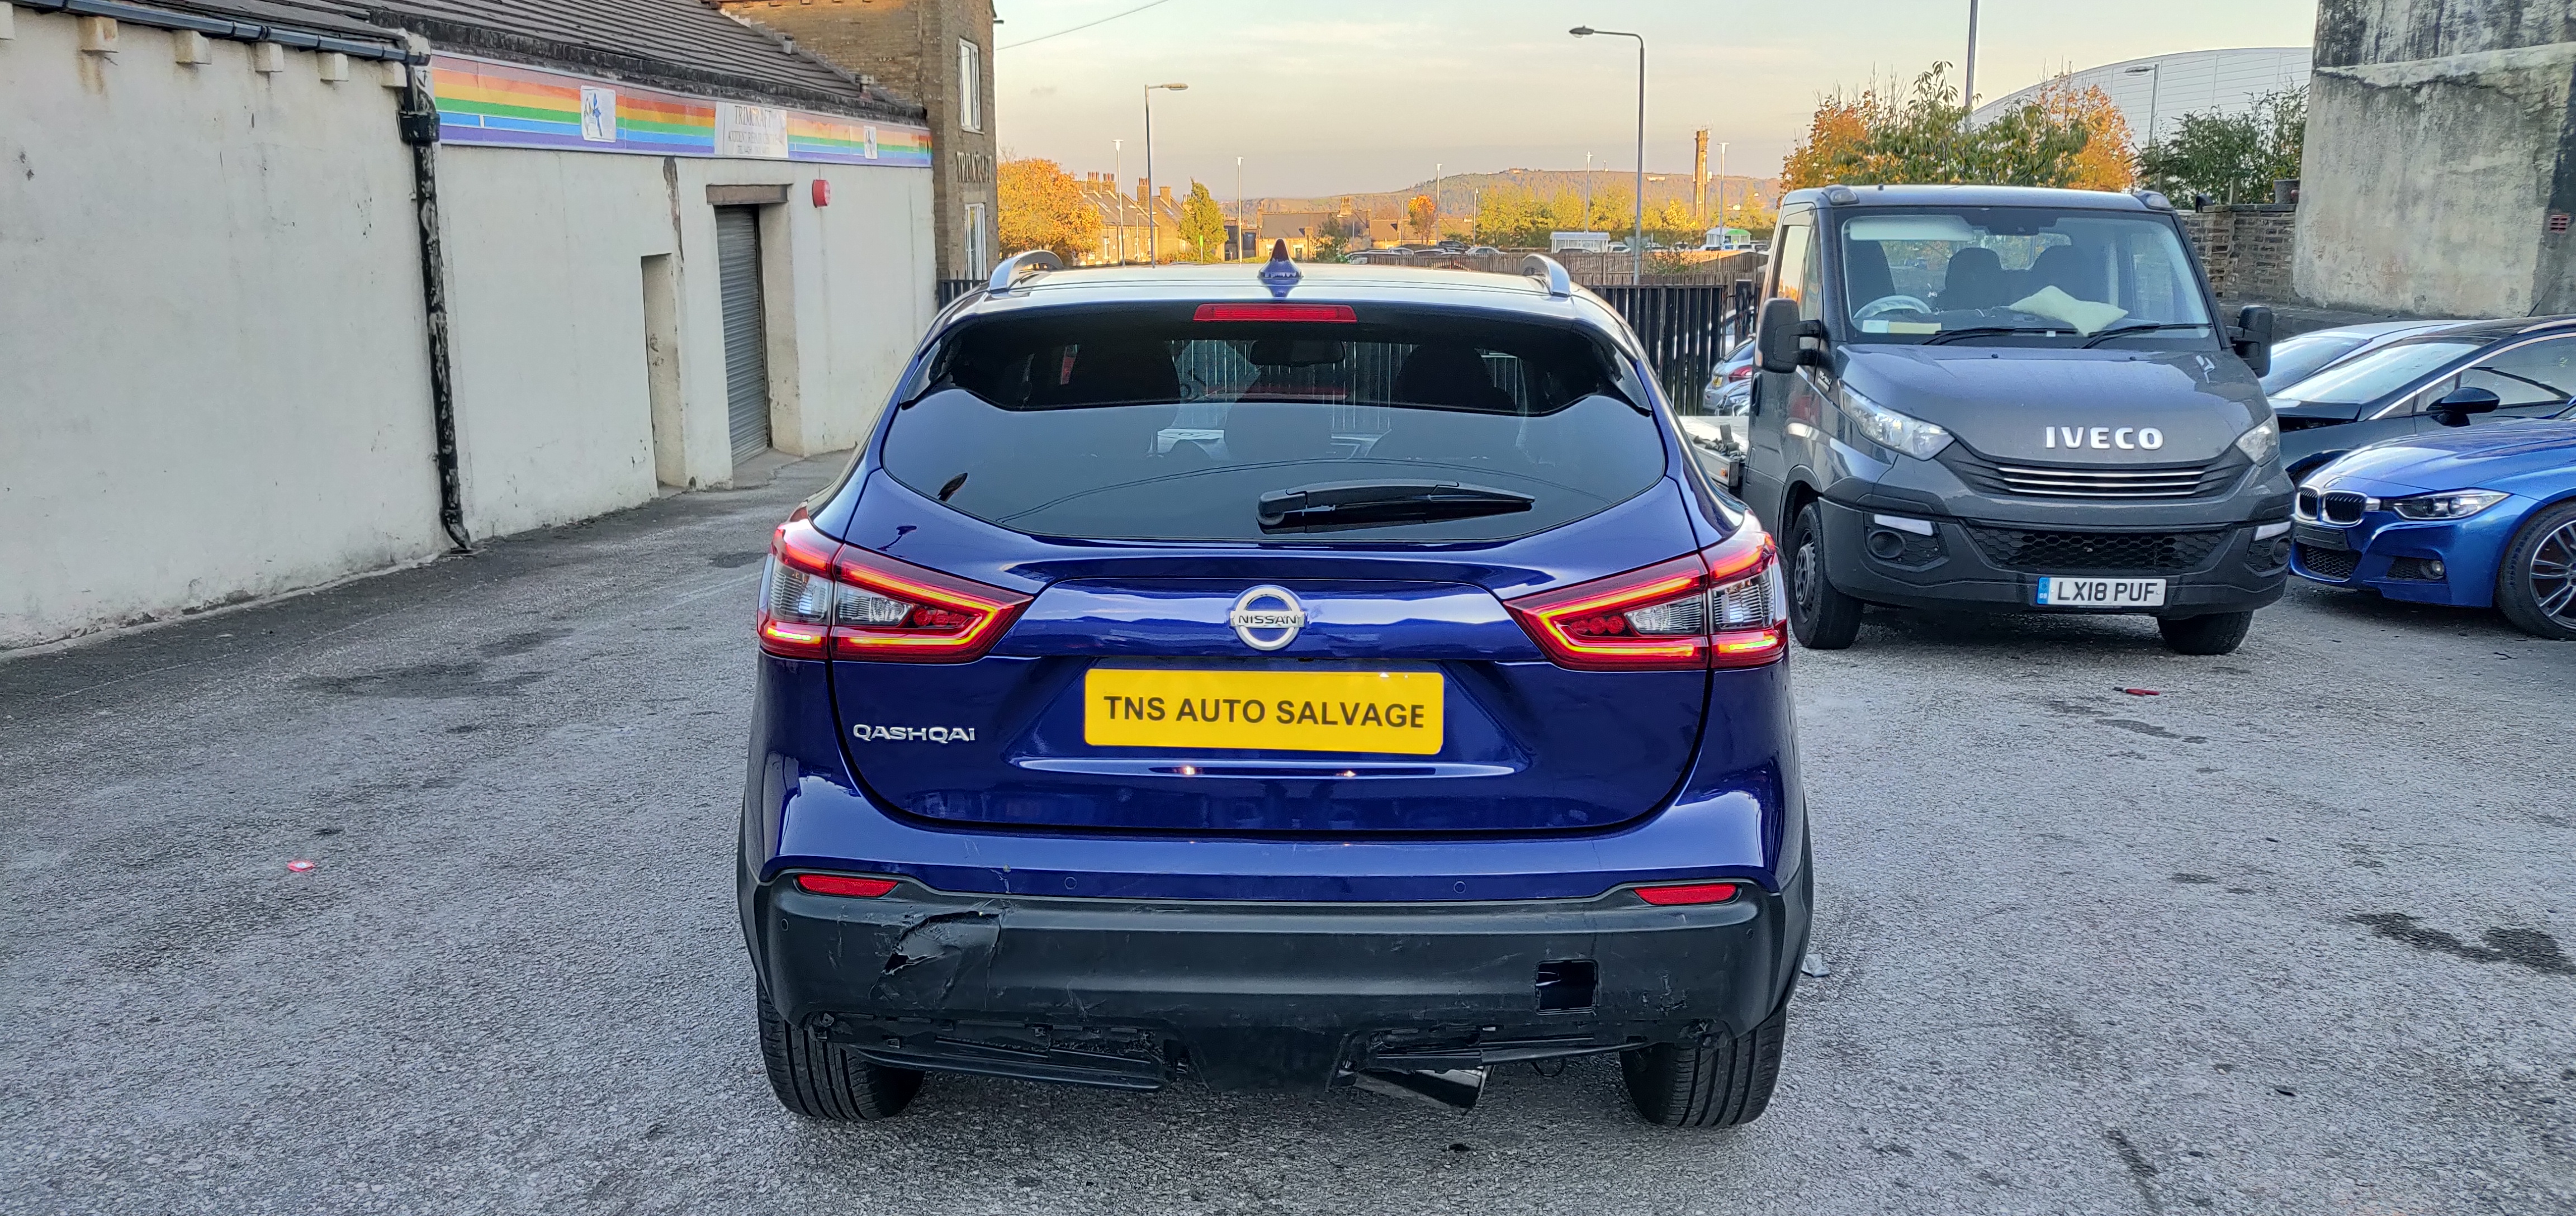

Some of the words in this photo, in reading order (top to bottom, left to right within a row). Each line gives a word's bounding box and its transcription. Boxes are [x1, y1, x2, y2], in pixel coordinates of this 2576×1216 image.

[735, 105, 771, 128] TRIMCRAFT
[2045, 426, 2165, 450] IVECO
[2057, 581, 2108, 601] LX18
[2114, 582, 2157, 602] PUF
[1238, 615, 1297, 624] NISSAN
[1104, 695, 1166, 721] TNS
[1176, 697, 1266, 724] AUTO
[1276, 700, 1424, 728] SALVAGE
[853, 724, 976, 744] QASHQAI
